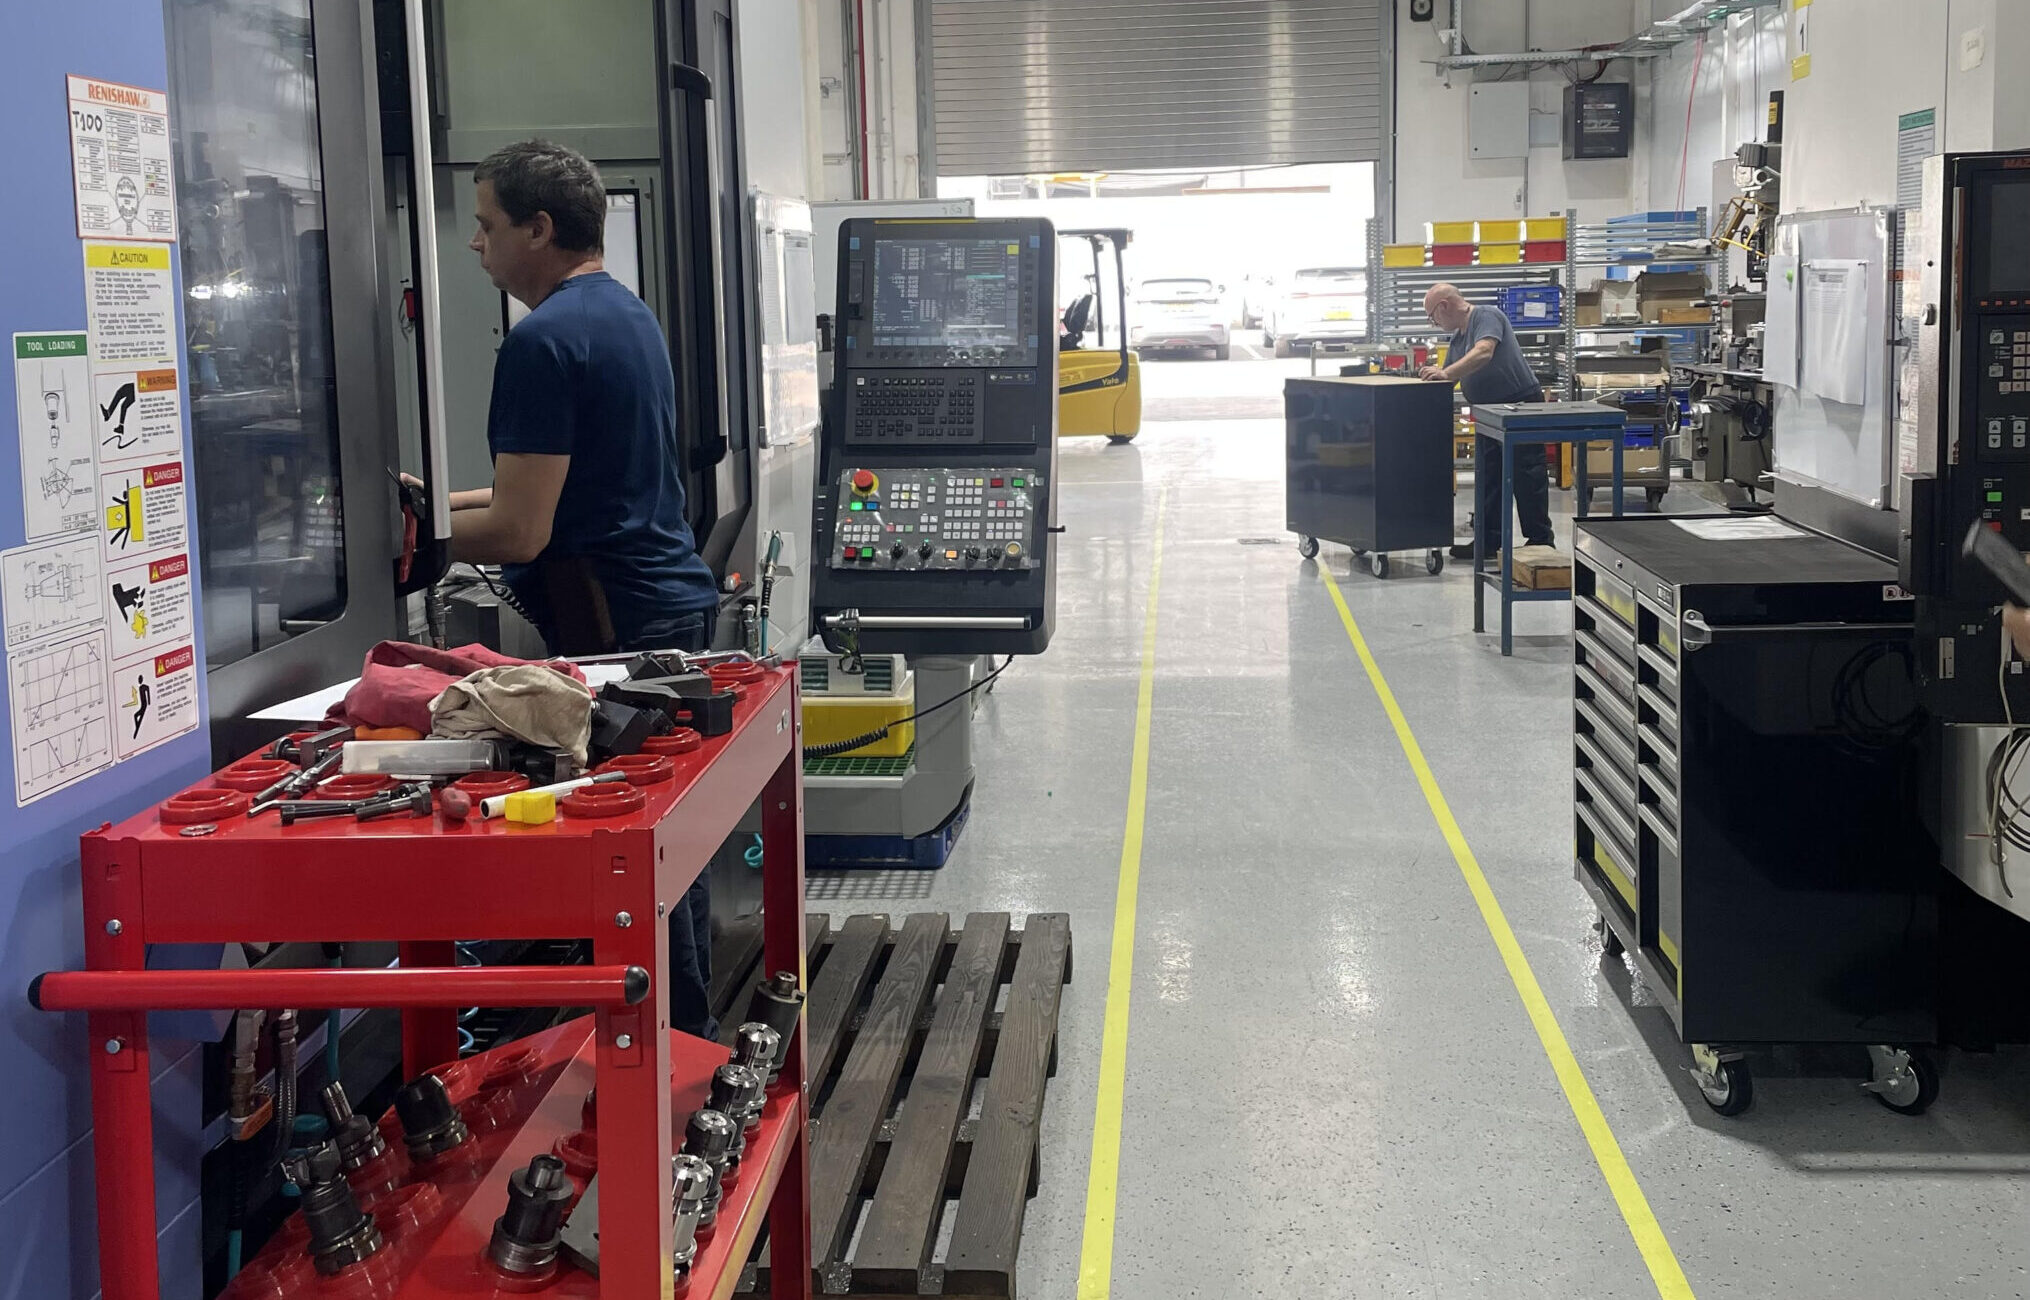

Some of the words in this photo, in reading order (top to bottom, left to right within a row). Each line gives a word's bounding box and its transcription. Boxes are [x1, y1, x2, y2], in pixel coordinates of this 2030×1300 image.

[88, 83, 140, 107] RENISHAW
[72, 111, 102, 132] T100
[120, 252, 148, 263] CAUTION
[27, 342, 44, 351] TOOL
[48, 341, 76, 351] LOADING
[153, 468, 180, 481] DANGER
[159, 560, 186, 576] DANGER
[164, 652, 192, 669] DANGER
